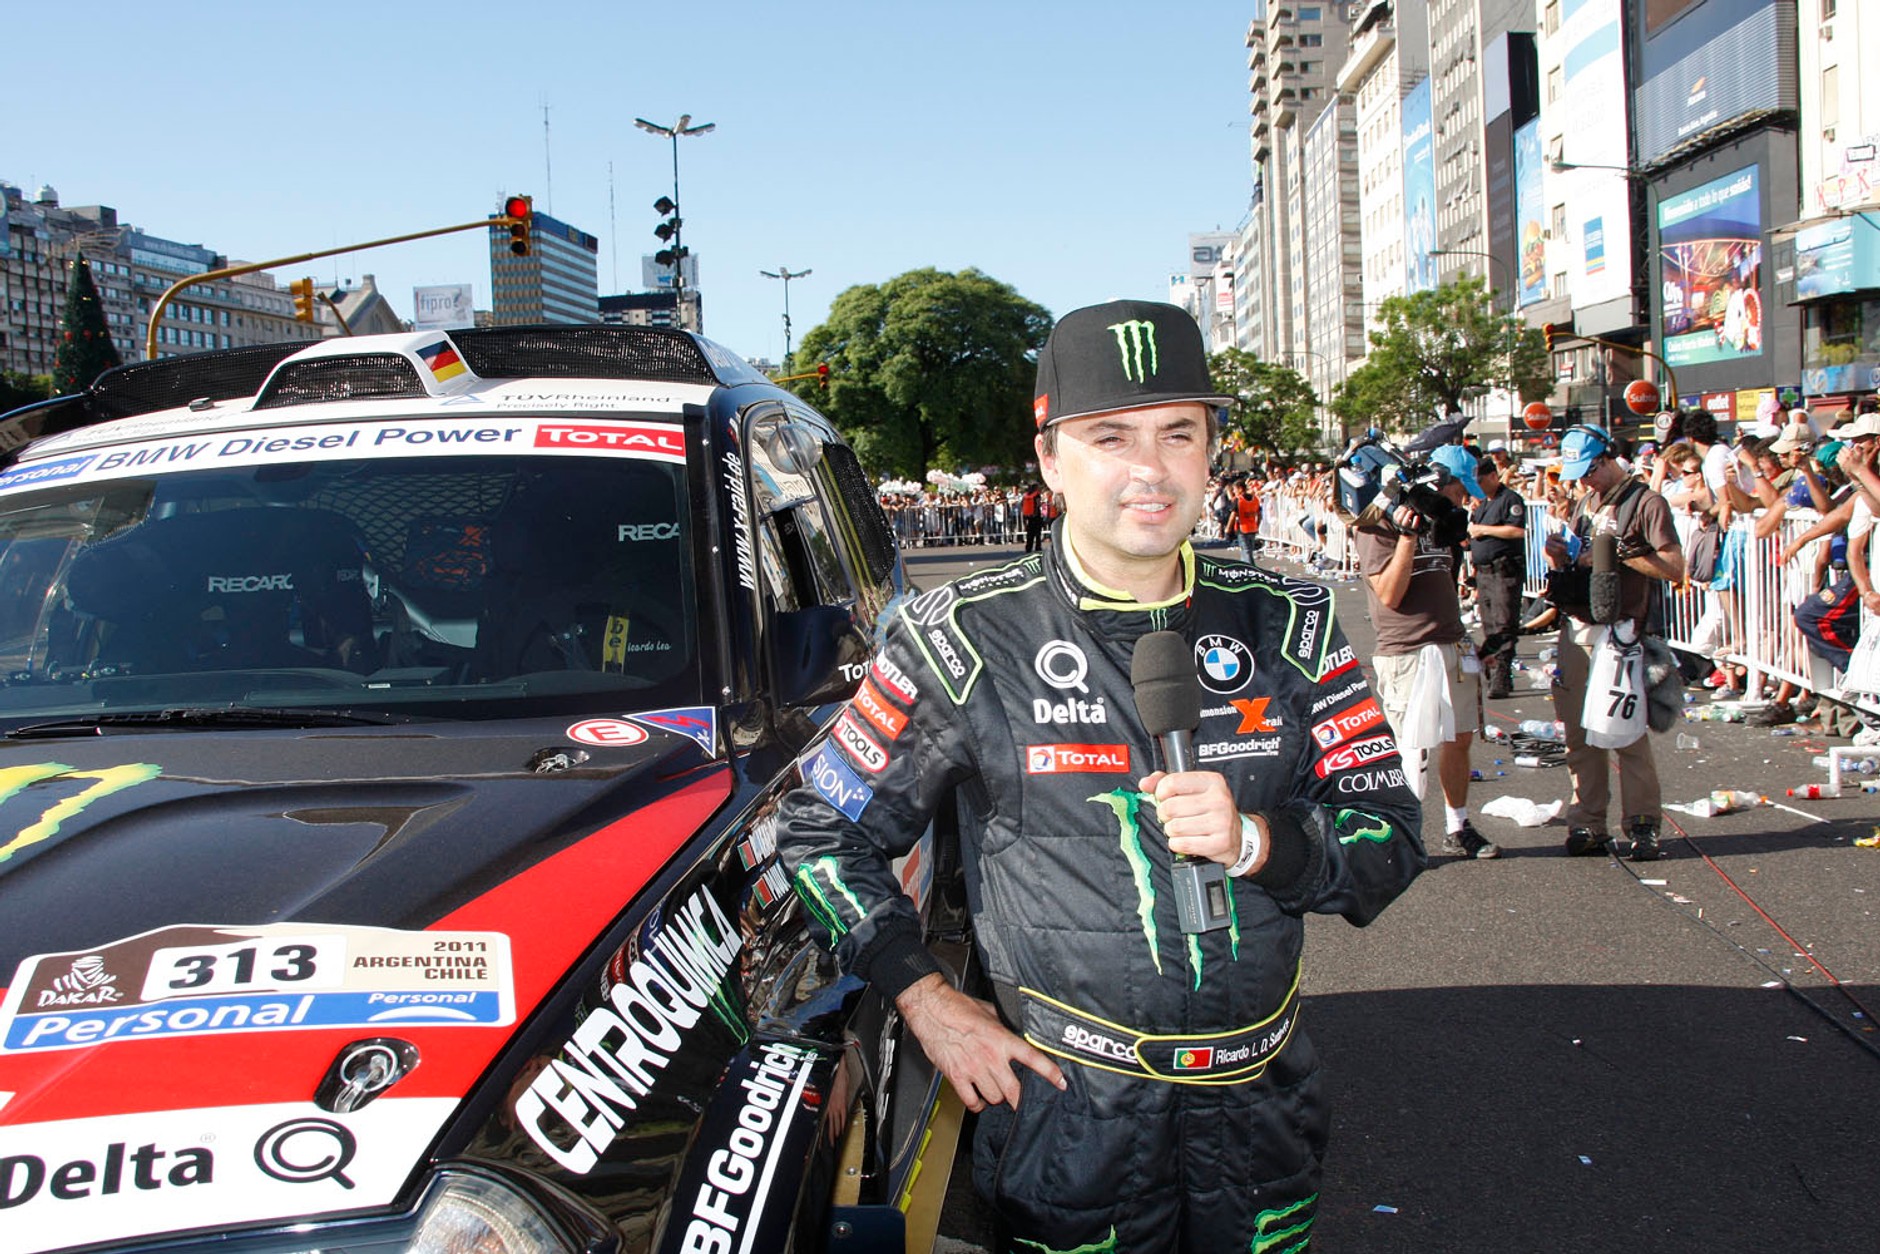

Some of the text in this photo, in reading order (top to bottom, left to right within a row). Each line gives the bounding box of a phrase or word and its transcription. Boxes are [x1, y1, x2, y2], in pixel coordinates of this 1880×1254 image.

[94, 426, 523, 472] BMW Diesel Power
[540, 428, 683, 451] TOTAL
[0, 456, 92, 487] ersonal
[838, 660, 870, 683] TOT
[857, 685, 897, 733] TOTAL
[1607, 689, 1638, 719] 76
[1337, 707, 1381, 731] TOTAL
[844, 722, 881, 765] TOOLS
[1323, 739, 1395, 775] KS TOOLS
[1057, 751, 1125, 766] TOTAL
[1338, 769, 1406, 793] COIMBR
[433, 941, 488, 953] 2011
[167, 943, 318, 990] 313
[352, 955, 488, 969] ARGENTINA
[424, 967, 489, 981] CHILE
[38, 984, 120, 1008] DAKAR
[367, 992, 478, 1005] Personal
[20, 995, 315, 1047] Personal
[515, 884, 743, 1174] CENTROQUIMICA
[1215, 1045, 1250, 1064] Ricardo
[680, 1042, 803, 1254] BFGoodrich
[0, 1143, 215, 1211] Delta
